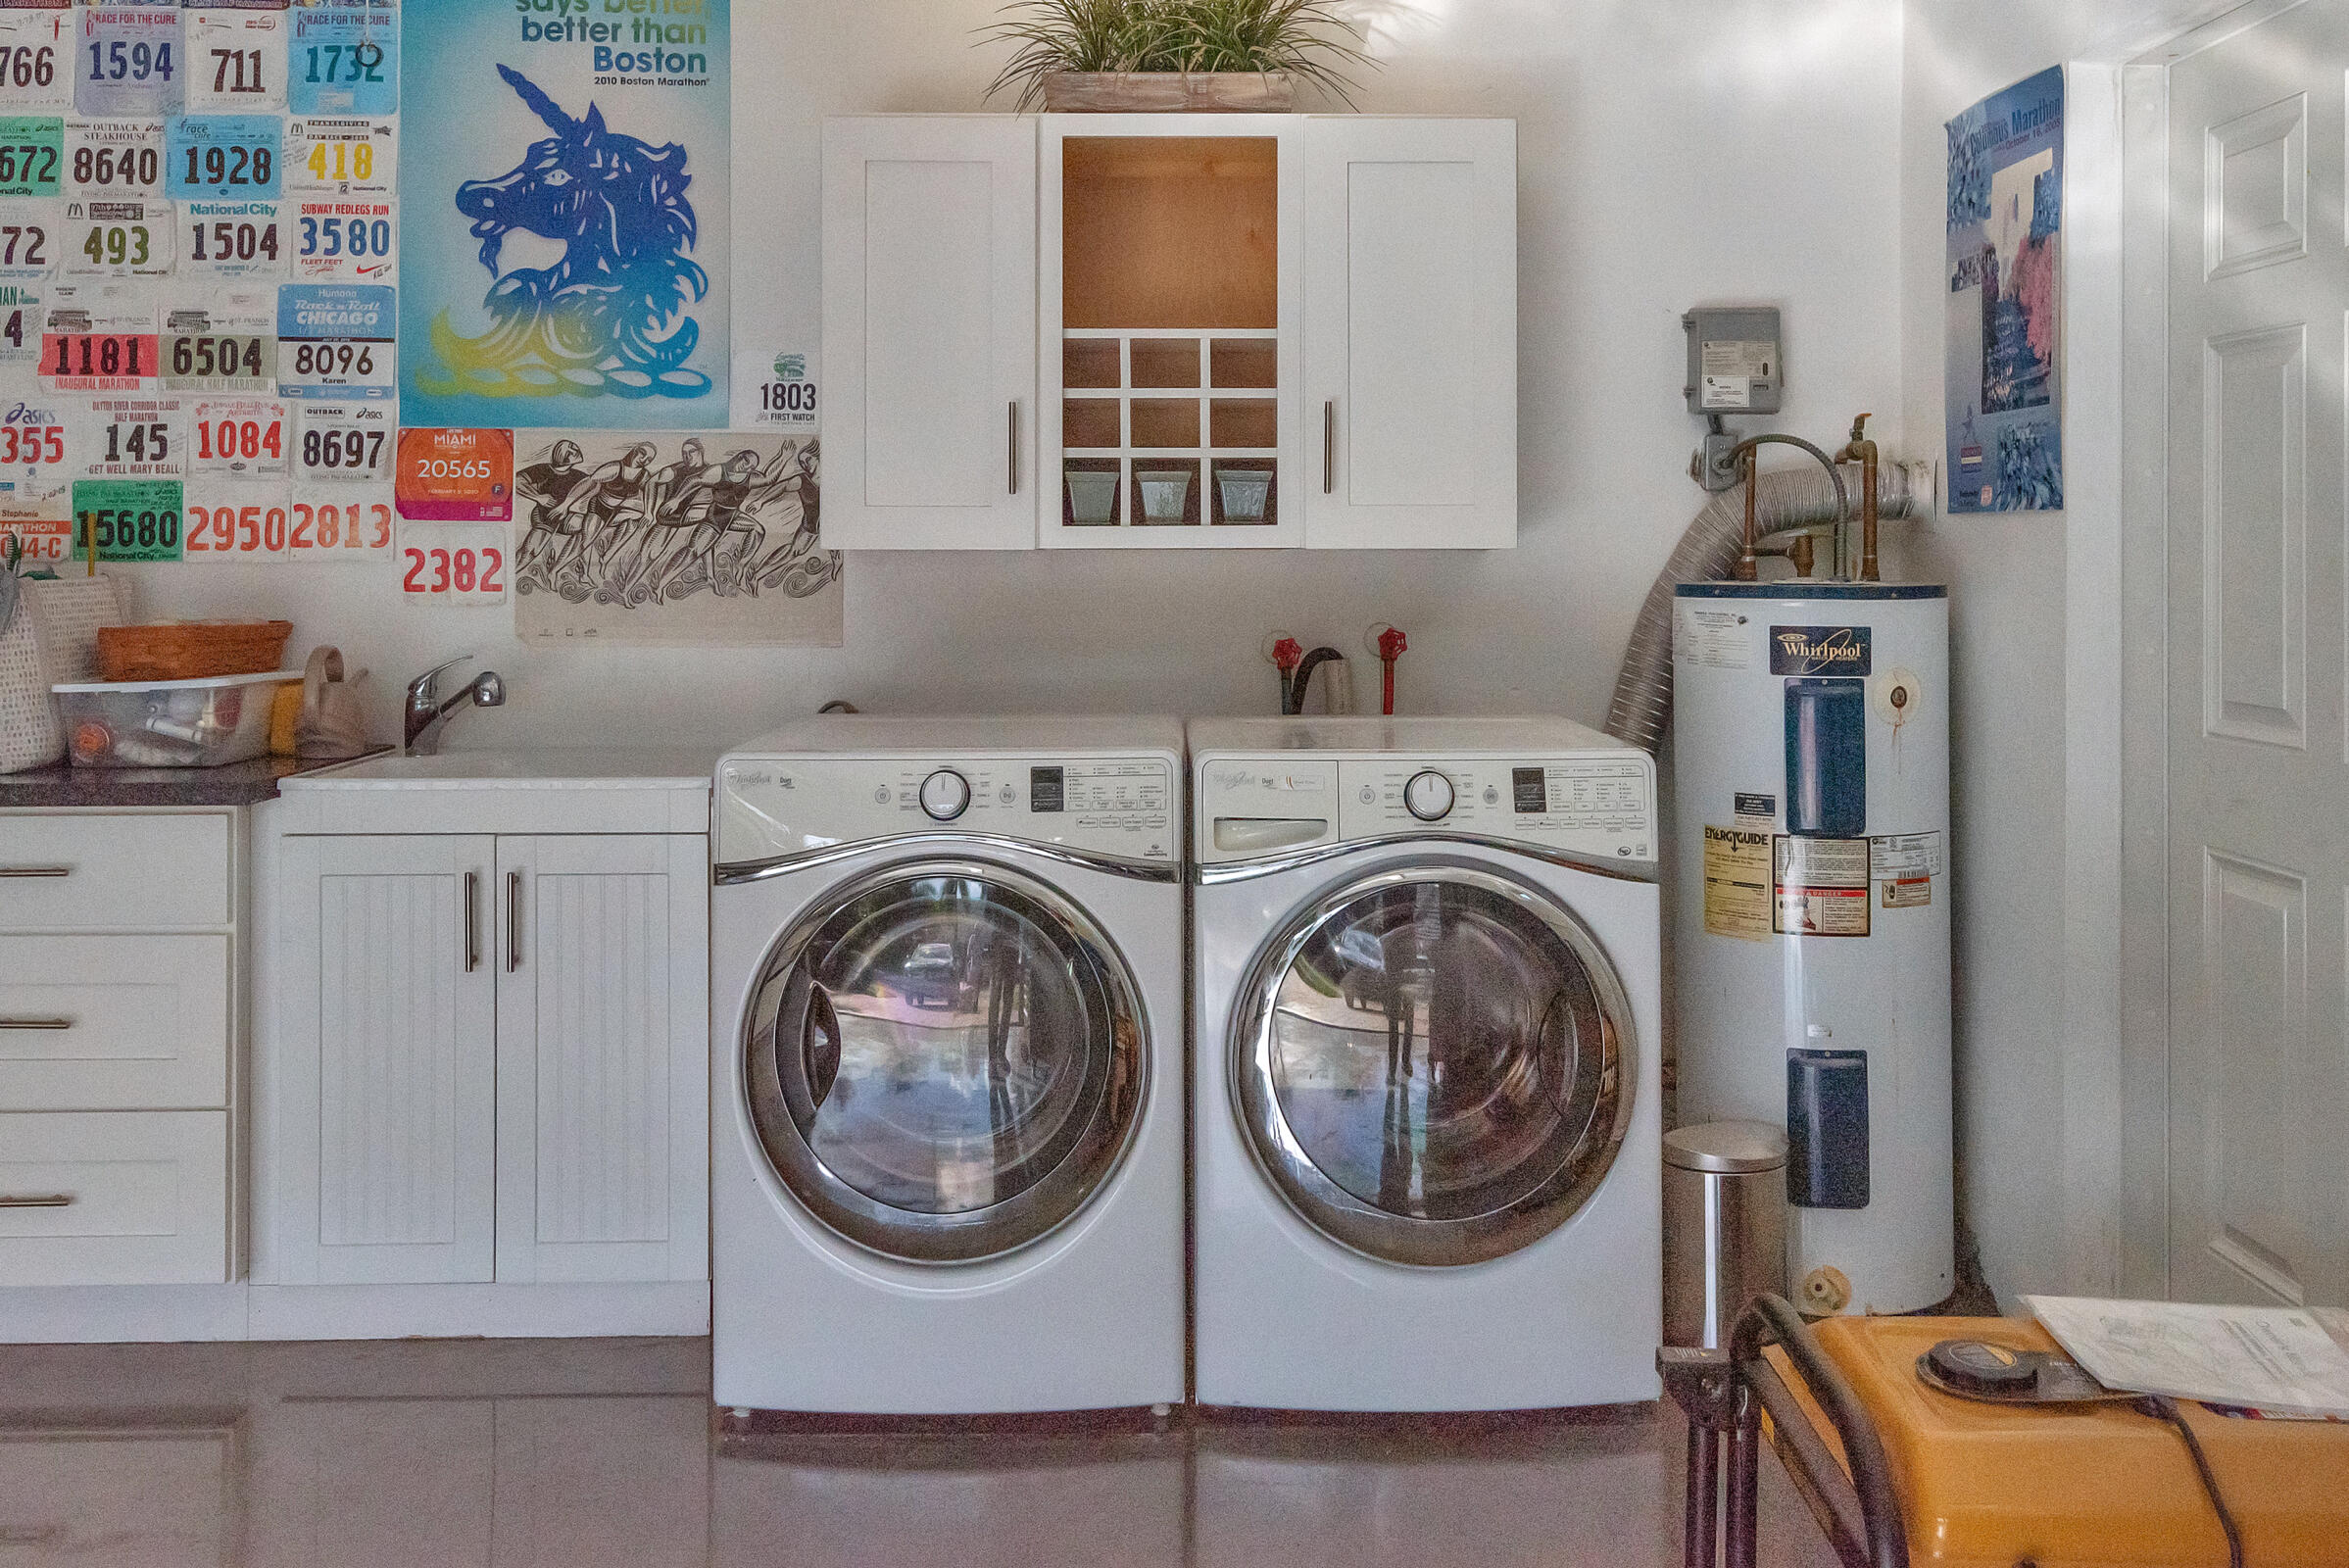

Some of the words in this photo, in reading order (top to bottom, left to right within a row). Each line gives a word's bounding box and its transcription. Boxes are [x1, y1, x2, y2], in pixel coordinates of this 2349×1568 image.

[95, 14, 118, 24] RACE
[120, 14, 135, 24] FOR
[137, 15, 153, 24] THE
[154, 15, 177, 24] CURE
[307, 15, 329, 25] RACE
[331, 15, 348, 25] FOR
[350, 15, 366, 25] THE
[367, 15, 390, 25] CURE
[515, 0, 589, 18] says
[521, 16, 622, 42] better
[631, 18, 707, 44] than
[89, 41, 174, 81] 1594
[211, 49, 266, 92] 711
[306, 45, 384, 83] 1732
[594, 46, 707, 74] Boston
[594, 76, 617, 85] 2010
[620, 77, 654, 86] Boston
[2012, 98, 2061, 136] Marathon
[84, 132, 148, 141] STEAKHOUSE
[73, 147, 158, 185] 8640
[184, 146, 271, 185] 1928
[308, 142, 373, 180] 418
[16, 187, 32, 196] City
[190, 204, 249, 216] National
[249, 203, 277, 217] City
[301, 204, 332, 215] SUBWAY
[335, 204, 370, 215] REDLEGS
[372, 205, 389, 216] RUN
[2, 225, 46, 265] 72
[84, 225, 150, 265] 493
[192, 222, 278, 261] 1504
[300, 217, 390, 257] 3580
[296, 312, 378, 325] CHICAGO
[318, 326, 374, 335] MARATHON
[56, 337, 141, 375] 1181
[173, 337, 262, 376] 6504
[296, 344, 373, 375] 8096
[55, 377, 97, 390] INAUGURAL
[99, 377, 140, 390] MARATHON
[760, 383, 816, 411] 1803
[23, 409, 55, 424] asics
[129, 413, 158, 422] MARATHON
[159, 401, 180, 411] CLASSIC
[365, 411, 383, 419] asics
[770, 413, 790, 421] FIRST
[792, 413, 815, 421] WATCH
[1, 426, 64, 465] 355
[105, 423, 169, 463] 145
[198, 420, 282, 459] 1084
[304, 430, 385, 468] 8697
[434, 434, 476, 446] MIAMI
[88, 465, 103, 474] GET
[106, 465, 126, 474] WELL
[130, 465, 152, 474] MARY
[155, 465, 179, 474] BEALL
[416, 460, 491, 478] 20565
[2, 510, 39, 518] Stephanie
[290, 504, 391, 548] 2813
[77, 510, 177, 548] 15680
[186, 507, 286, 551] 2950
[137, 552, 155, 561] City
[404, 548, 503, 593] 2382
[1783, 642, 1861, 662] Whirlpool
